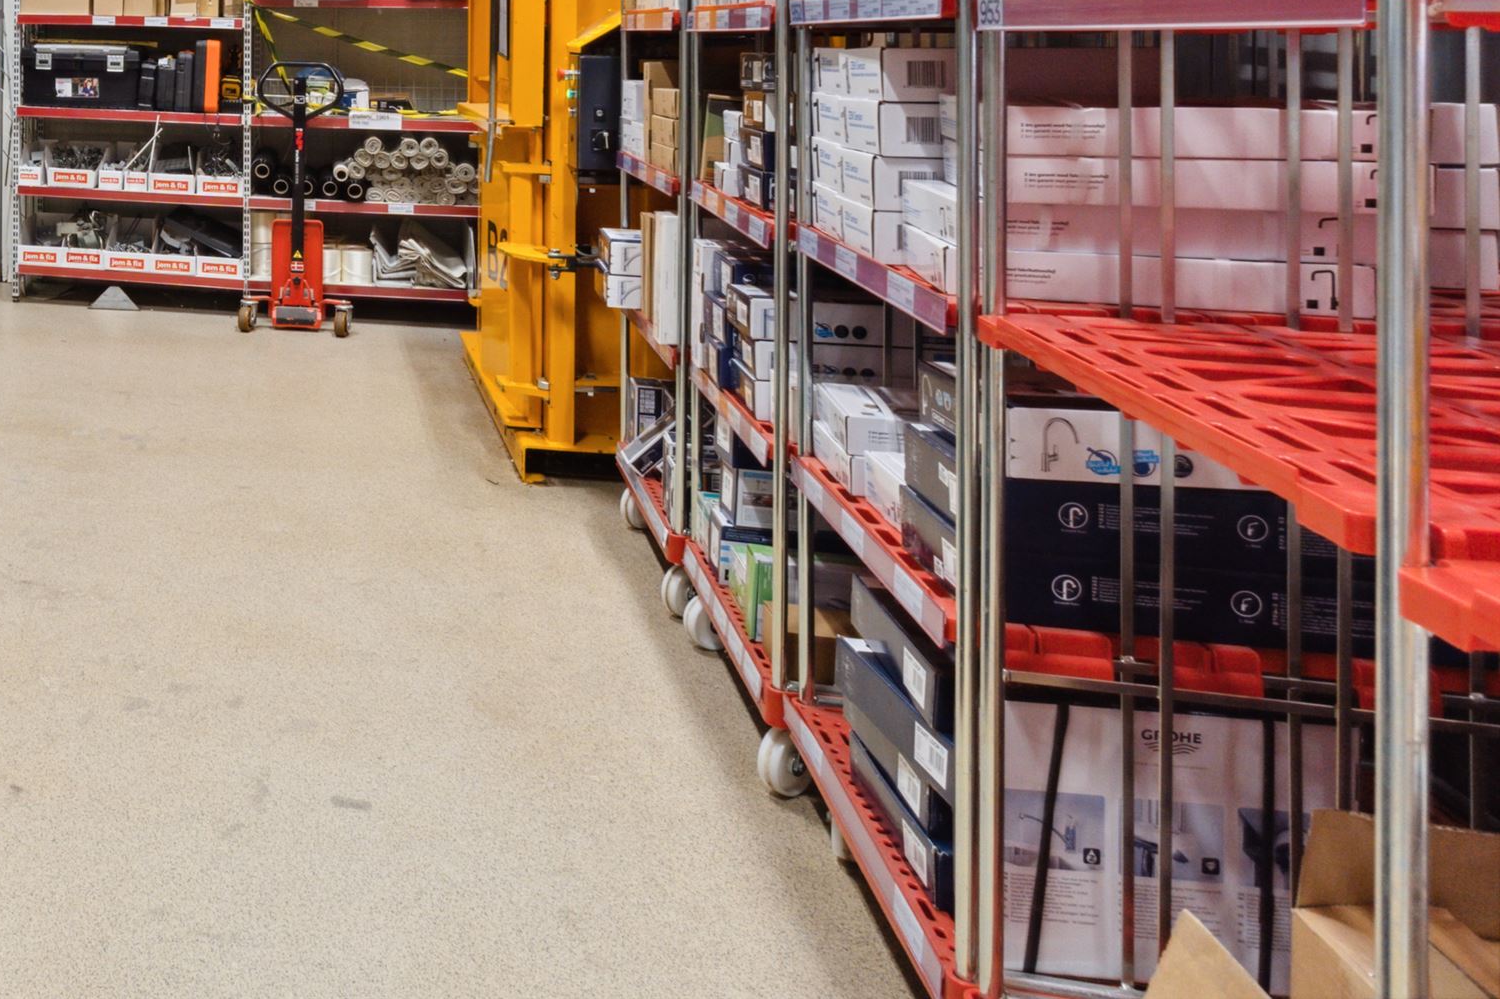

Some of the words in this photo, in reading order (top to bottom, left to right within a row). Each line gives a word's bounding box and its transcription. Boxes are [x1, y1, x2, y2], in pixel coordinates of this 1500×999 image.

[979, 0, 1001, 25] 953
[55, 173, 69, 181] jem
[155, 181, 169, 190] jem
[177, 182, 187, 190] fix
[204, 183, 219, 192] jem
[226, 184, 236, 192] fix
[25, 253, 39, 261] jem
[46, 253, 55, 261] fix
[68, 254, 82, 263] jem
[89, 254, 99, 262] fix
[111, 259, 125, 268] jem
[133, 259, 143, 268] fix
[157, 261, 171, 270] jem
[179, 261, 188, 270] fix
[203, 263, 218, 273] jem
[225, 264, 235, 273] fix
